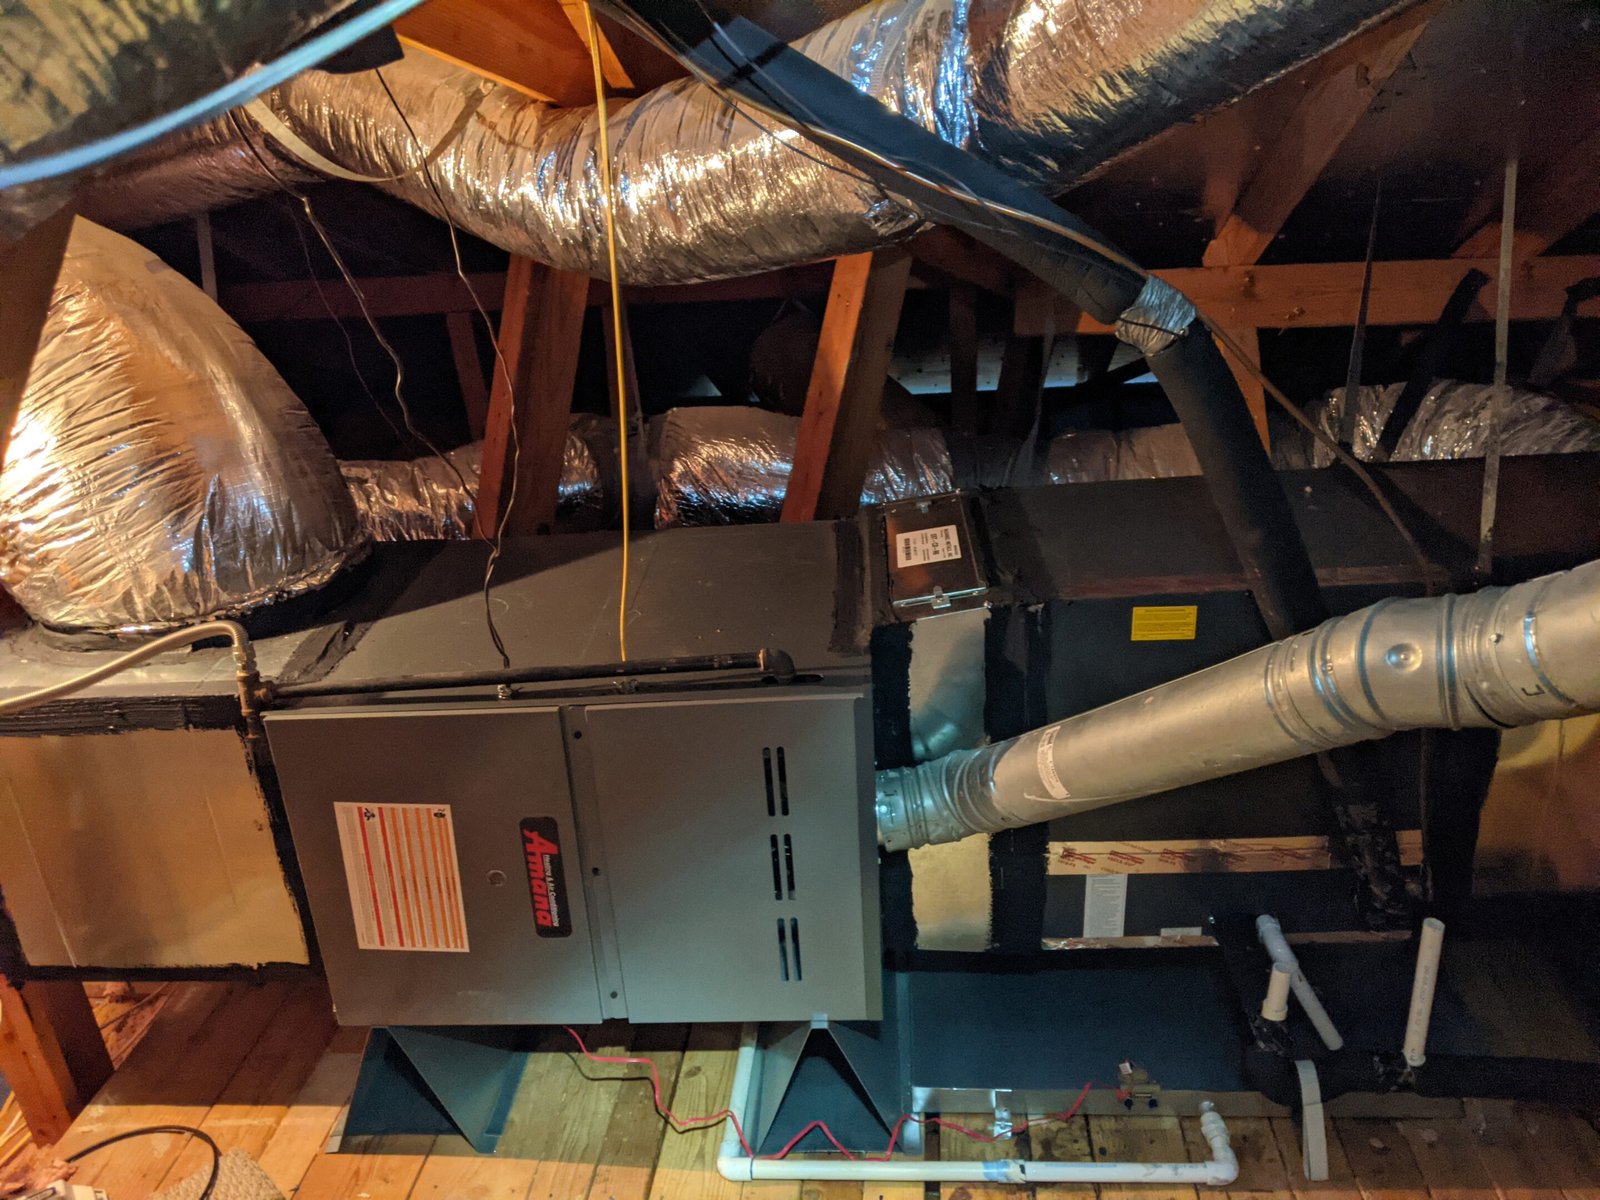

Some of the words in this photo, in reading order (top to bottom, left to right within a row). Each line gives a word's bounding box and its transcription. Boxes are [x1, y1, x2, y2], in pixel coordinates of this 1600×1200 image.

[524, 829, 558, 927] Amana
[543, 854, 551, 876] Heating
[549, 891, 560, 927] Conditioning
